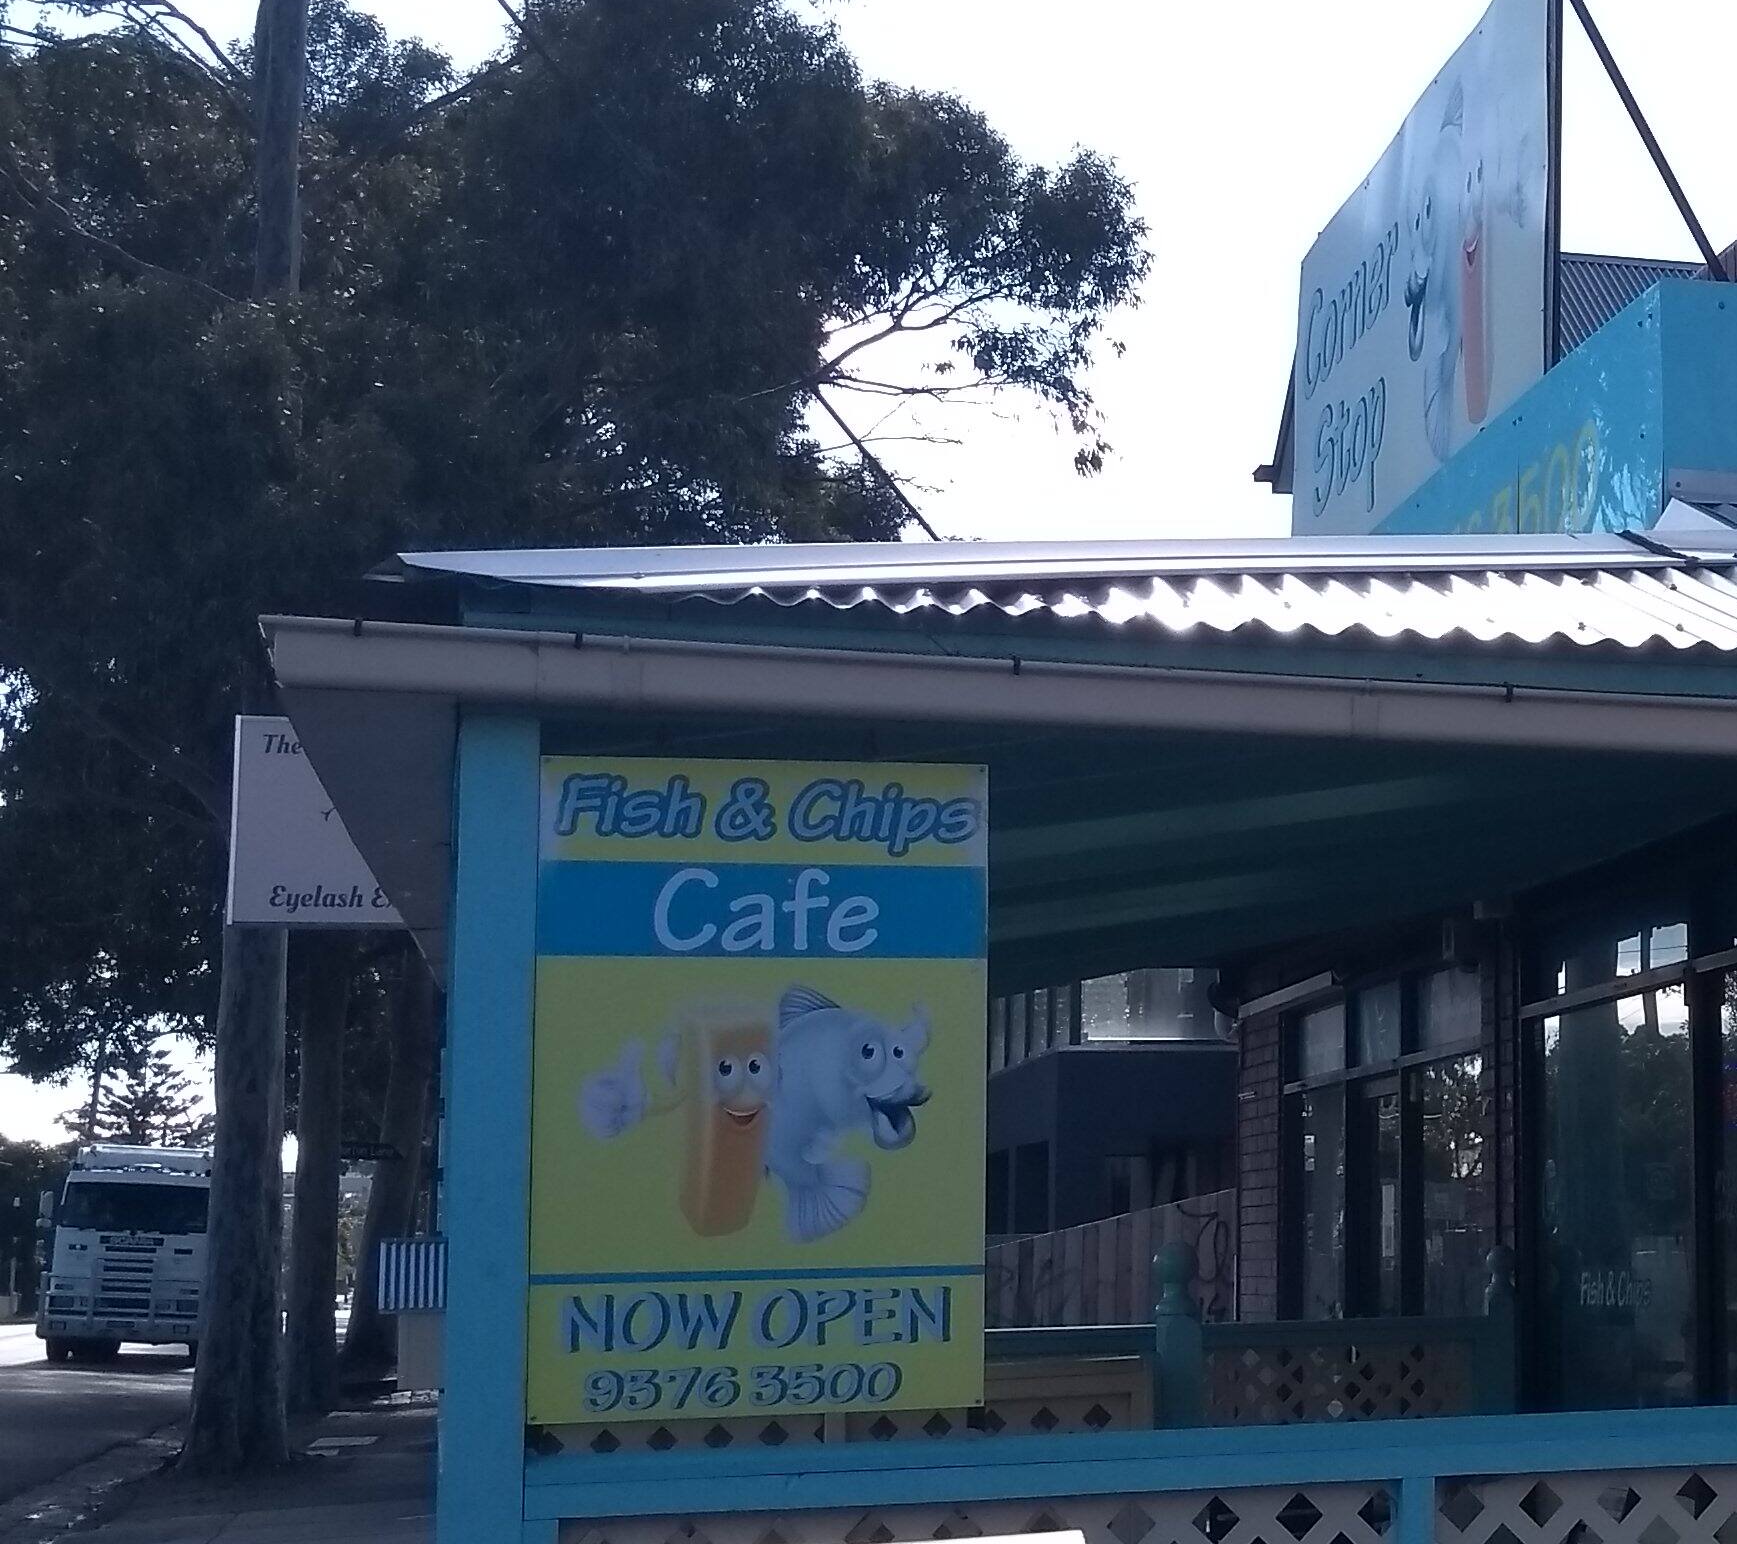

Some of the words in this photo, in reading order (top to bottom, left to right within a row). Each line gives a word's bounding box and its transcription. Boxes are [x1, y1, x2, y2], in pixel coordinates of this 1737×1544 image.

[1304, 220, 1400, 401] Corner
[1312, 375, 1388, 518] Stop
[263, 733, 304, 755] The
[556, 772, 705, 838] Fish
[715, 777, 777, 842] &
[788, 779, 981, 857] Chips
[268, 885, 364, 914] Eyelash
[370, 885, 392, 908] E
[653, 867, 880, 953] Cafe
[562, 1290, 743, 1354] NOW
[749, 1284, 952, 1350] OPEN
[1579, 1270, 1604, 1307] Fish
[1605, 1270, 1617, 1307] &
[1617, 1270, 1652, 1308] Chips
[583, 1365, 741, 1413] 9376
[748, 1361, 904, 1407] 3500
